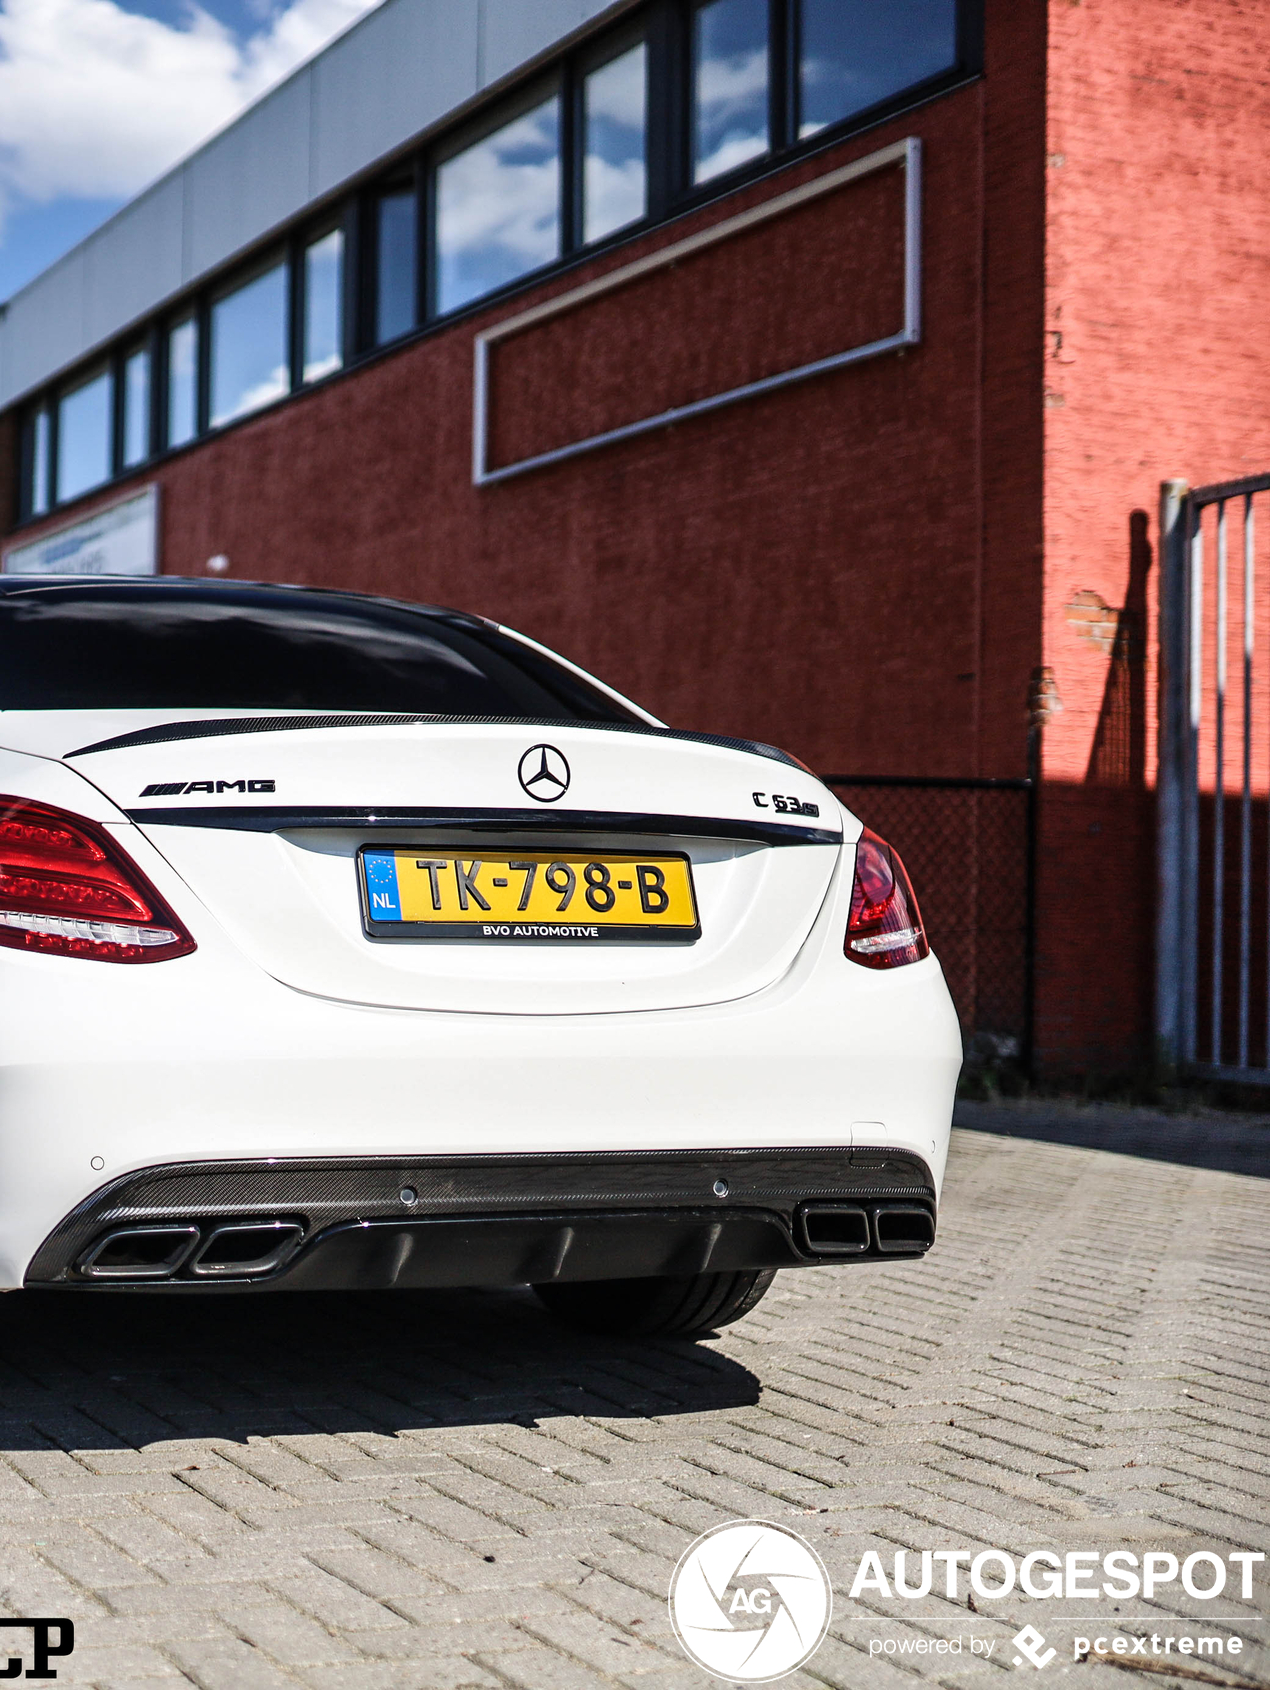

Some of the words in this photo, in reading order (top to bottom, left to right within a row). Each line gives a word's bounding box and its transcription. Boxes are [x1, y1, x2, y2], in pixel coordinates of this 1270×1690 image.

[182, 780, 276, 795] AMG
[752, 792, 769, 808] C
[416, 860, 670, 914] TK-798-B
[372, 892, 397, 909] NL
[482, 925, 511, 936] BVO
[513, 926, 599, 937] AUTOMOTIVE
